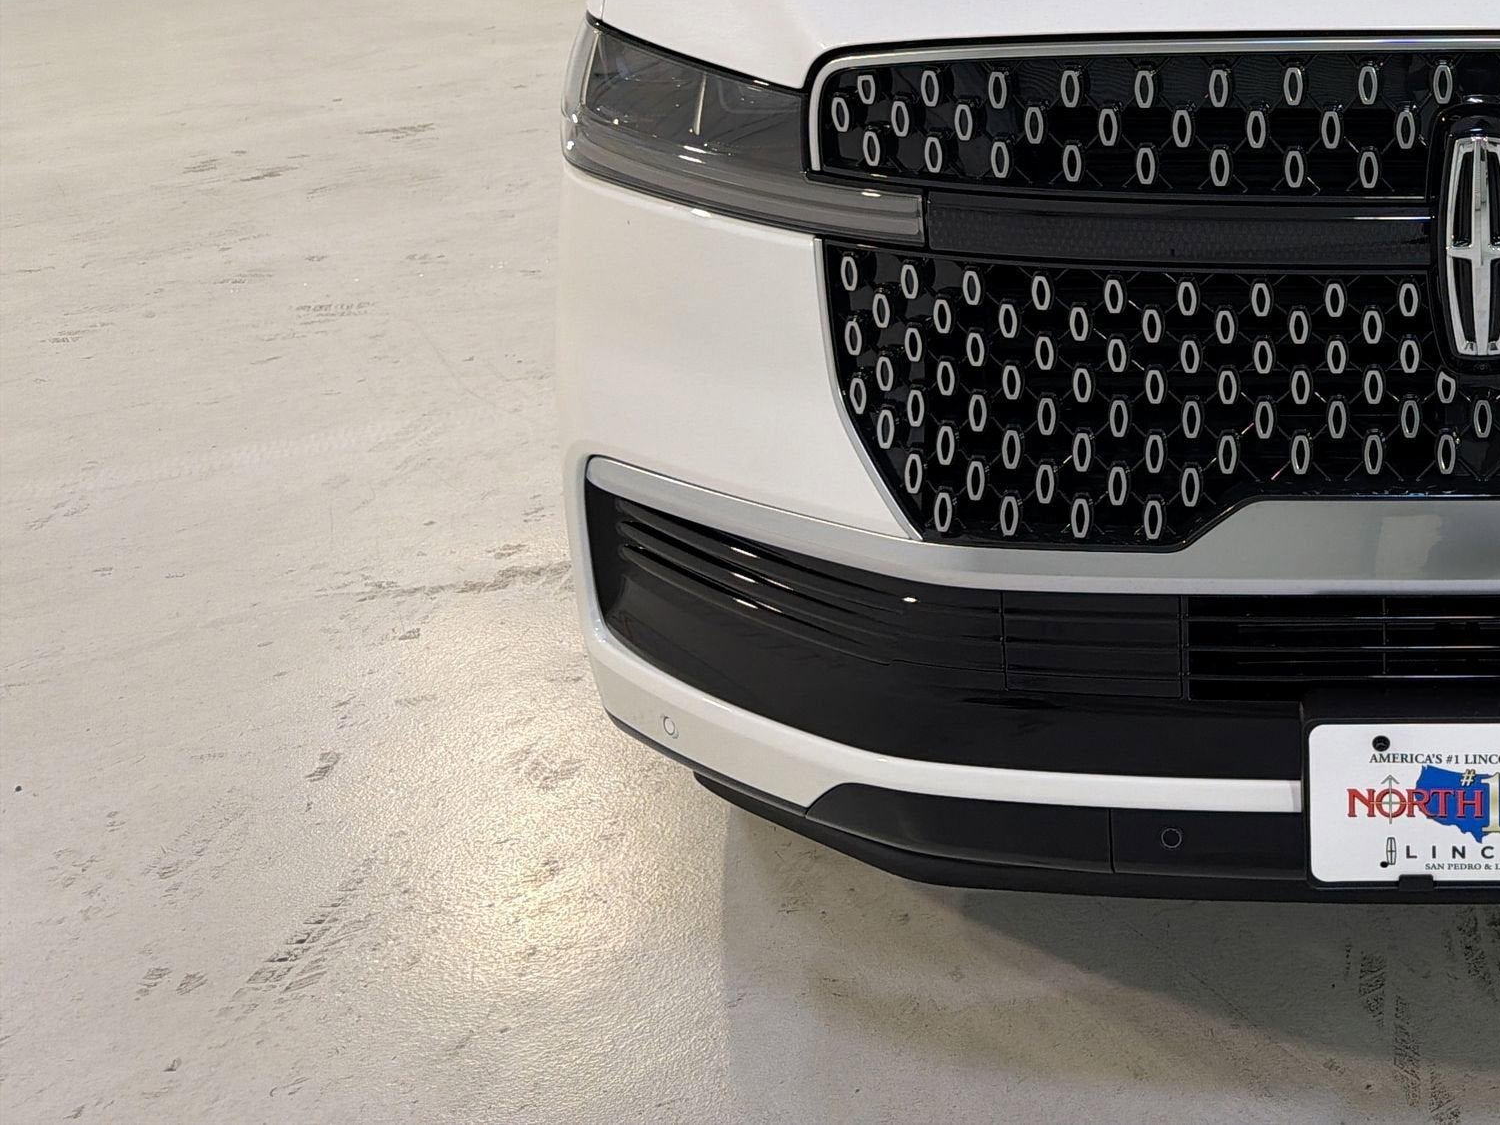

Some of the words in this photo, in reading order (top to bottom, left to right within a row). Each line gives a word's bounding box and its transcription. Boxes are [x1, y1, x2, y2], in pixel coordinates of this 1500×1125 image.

[1369, 753, 1443, 764] AMERICA'S
[1446, 754, 1459, 765] #1
[1346, 788, 1483, 819] NORTH
[1425, 862, 1444, 871] SAN
[1447, 862, 1481, 871] PEDRO
[1484, 863, 1493, 871] &
